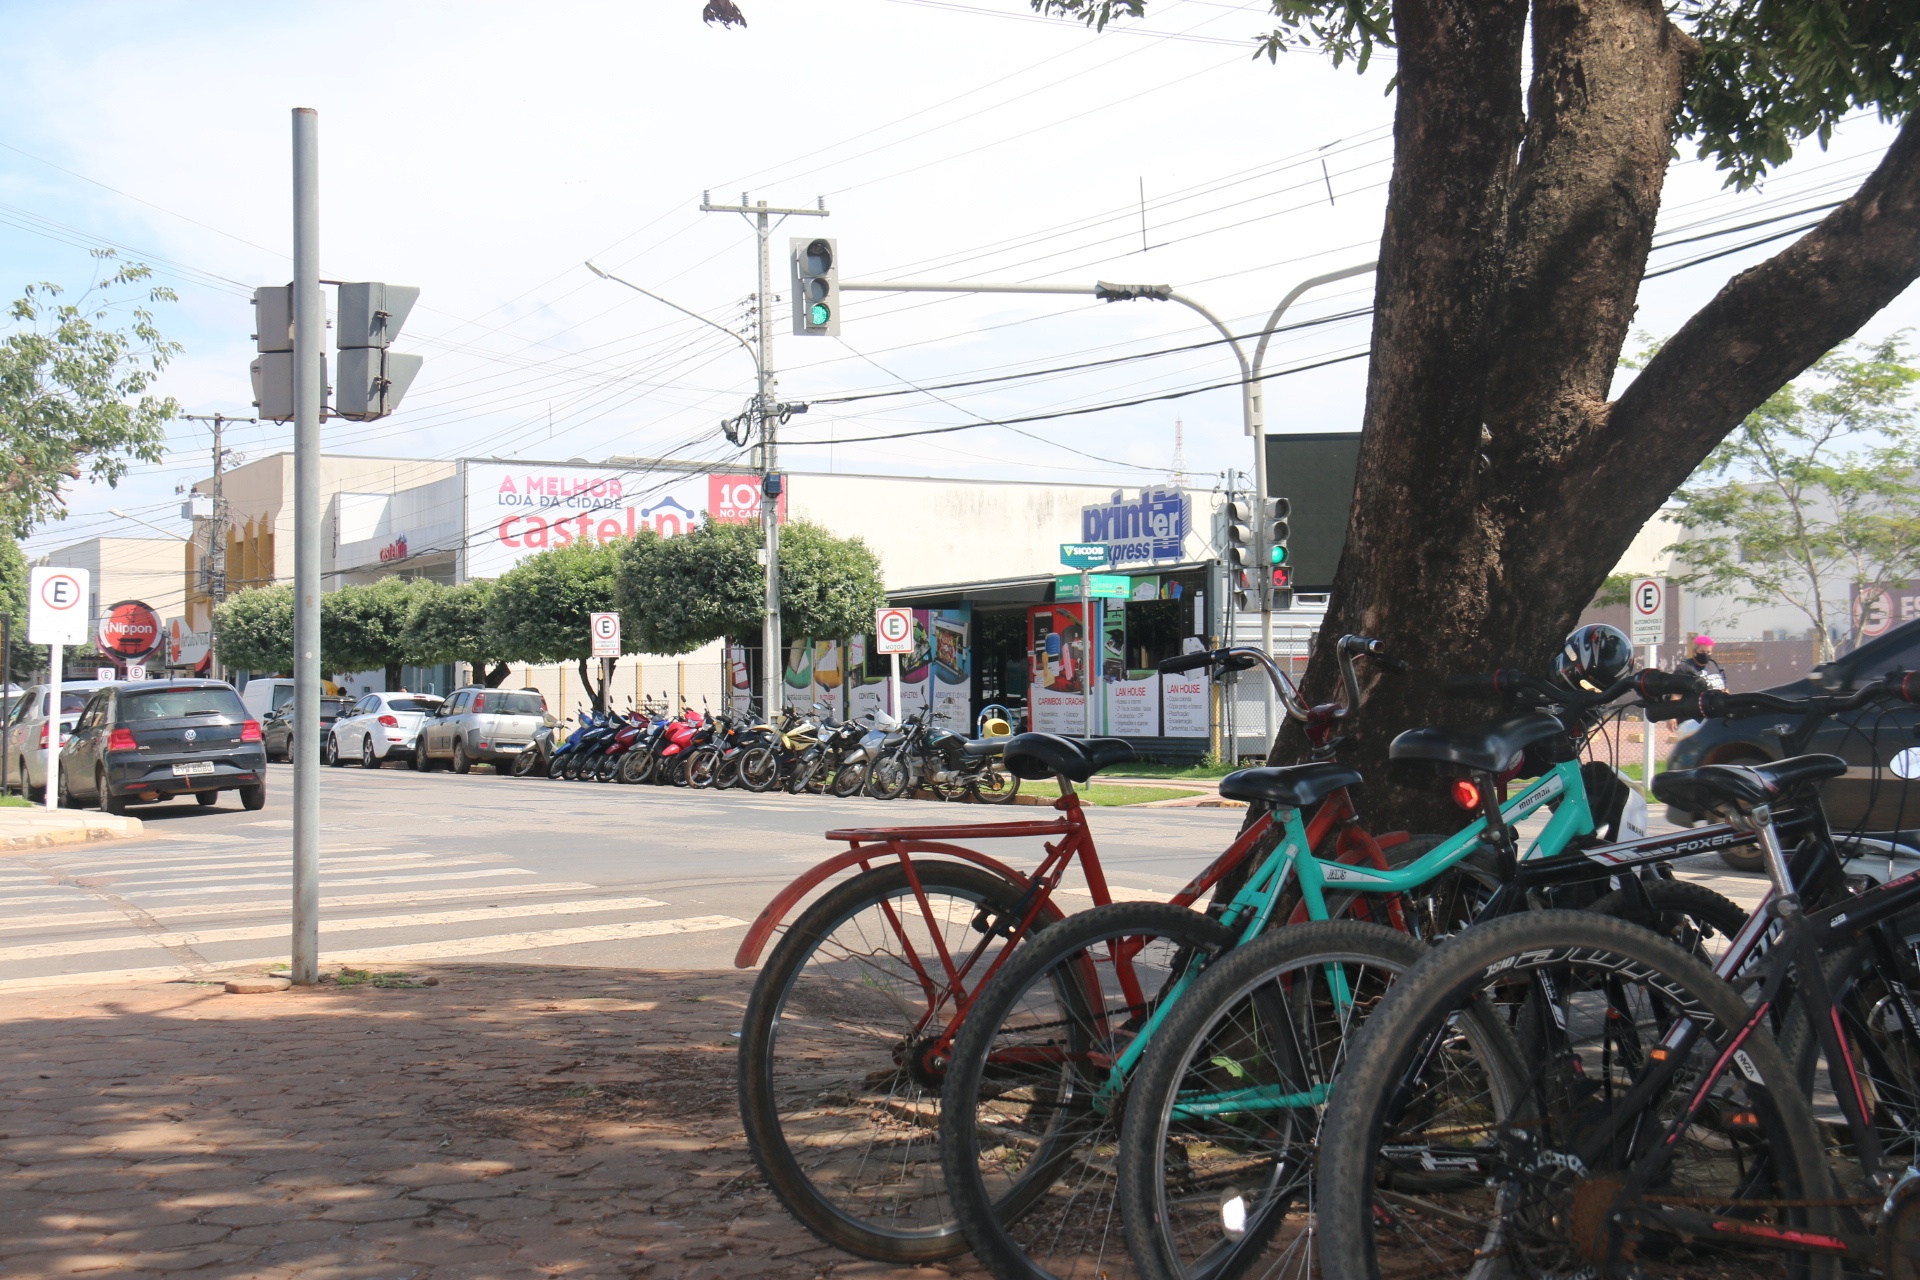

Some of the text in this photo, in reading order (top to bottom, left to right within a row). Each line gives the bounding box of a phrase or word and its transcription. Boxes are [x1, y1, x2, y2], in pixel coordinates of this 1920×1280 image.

[498, 475, 624, 499] A MELHOR
[498, 494, 622, 510] LOJA DA CIDADE
[720, 509, 735, 518] NO
[1083, 490, 1178, 543] printer
[1073, 546, 1104, 556] SICOOB
[1107, 541, 1150, 566] xpress
[53, 581, 68, 603] E
[1643, 588, 1653, 608] E
[109, 622, 153, 636] Nippon
[602, 620, 610, 634] E
[889, 618, 899, 635] E
[104, 671, 110, 679] E
[134, 668, 140, 677] E
[1115, 687, 1146, 697] LAN HOUSE
[1167, 684, 1201, 694] LAN HOUSE
[1038, 697, 1062, 706] CARIMBOS
[1626, 821, 1644, 837] YAMAHA
[1675, 833, 1736, 854] FOXER
[1326, 869, 1347, 880] JAWS
[1830, 912, 1847, 928] 29
[1738, 1053, 1754, 1078] VZAN
